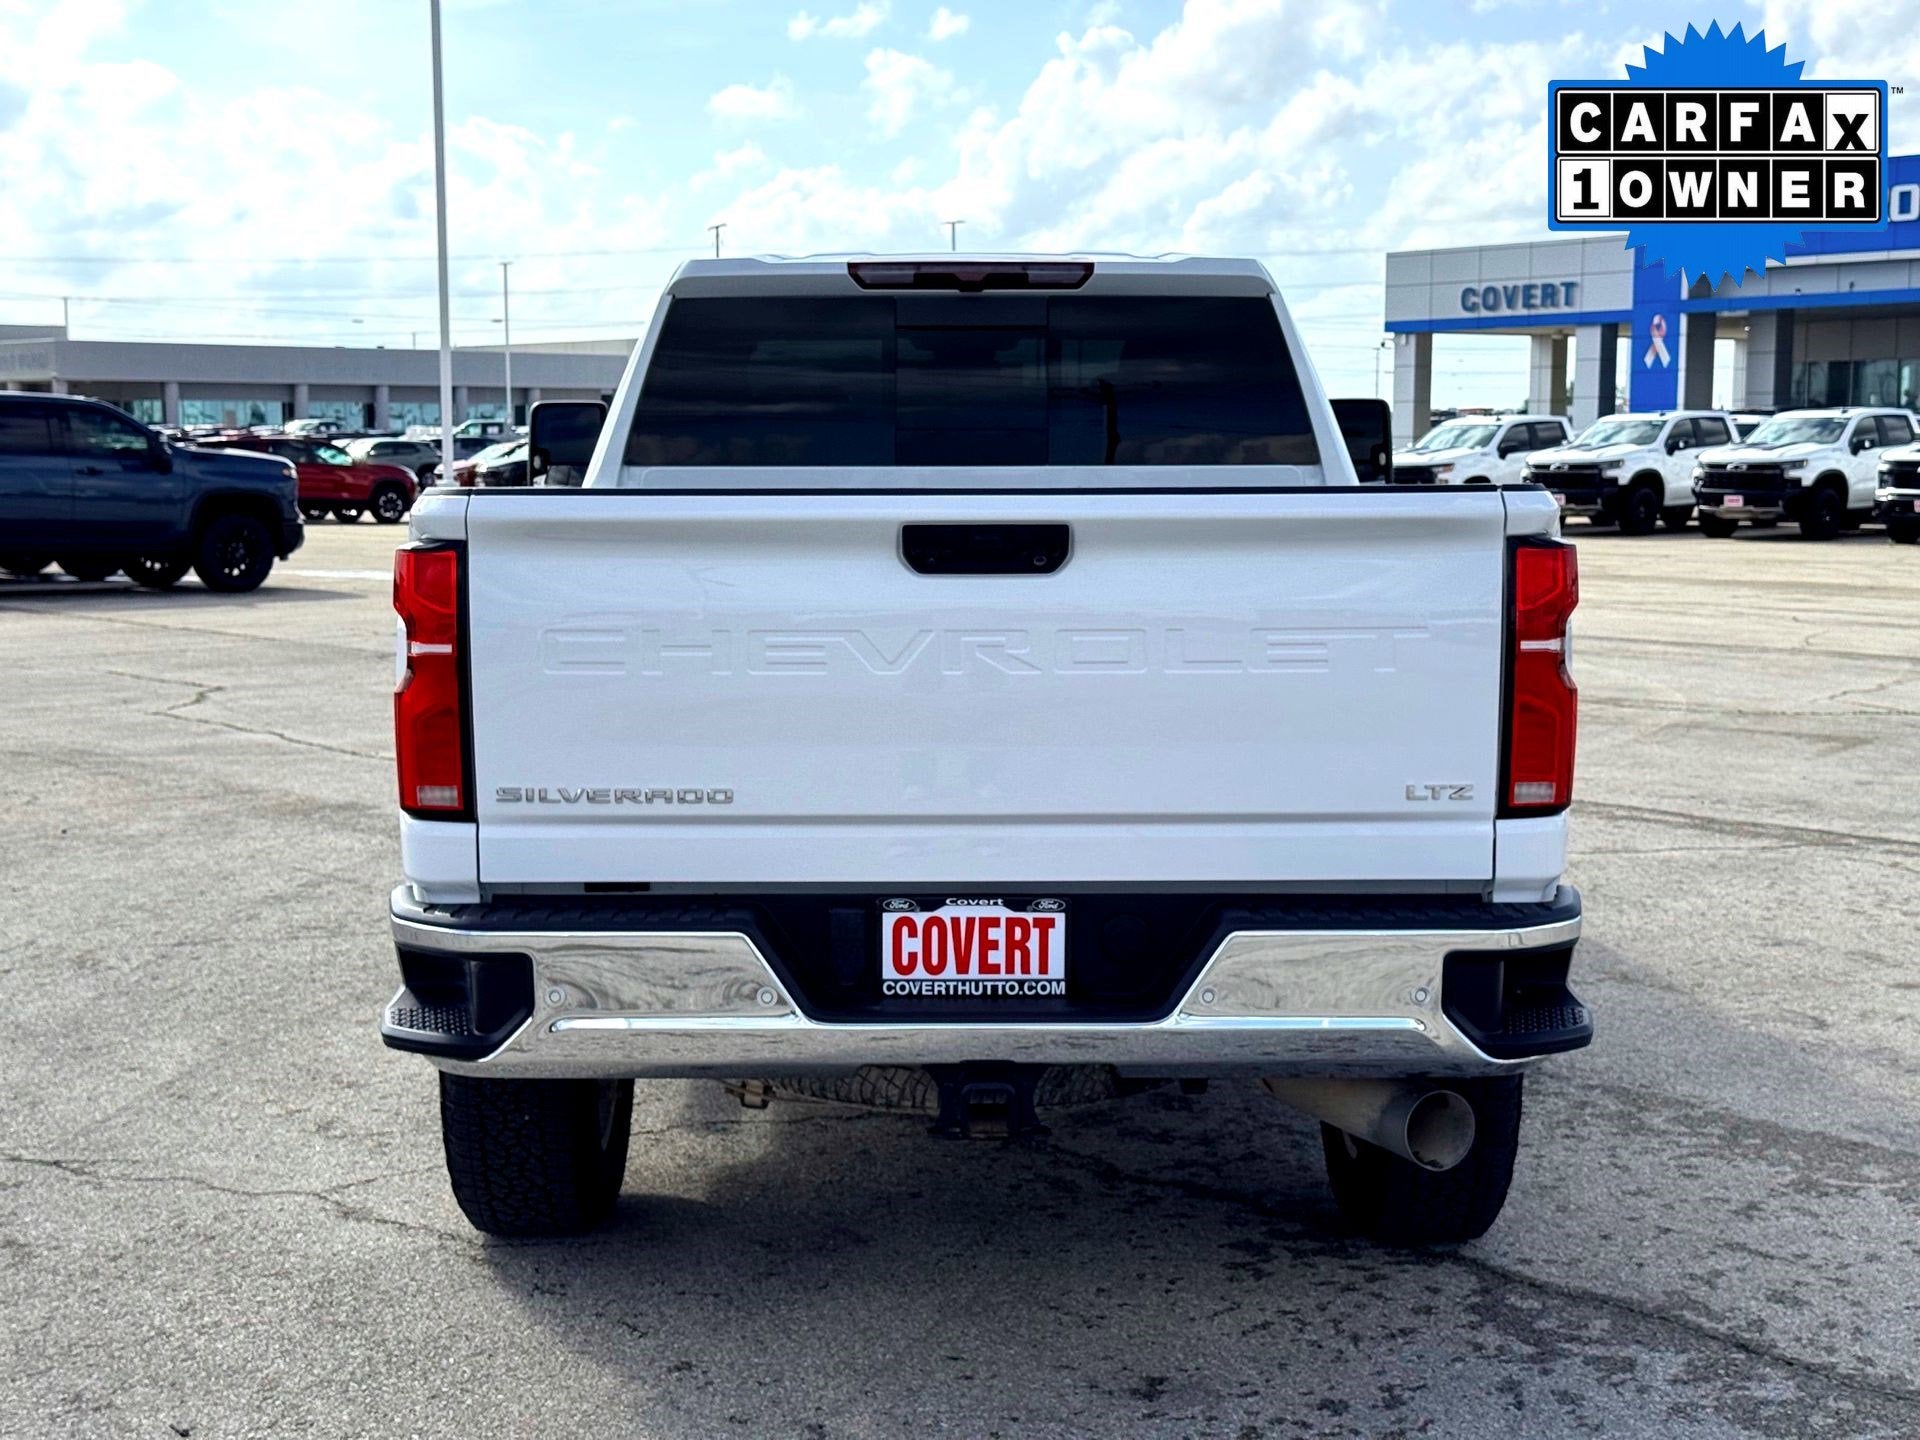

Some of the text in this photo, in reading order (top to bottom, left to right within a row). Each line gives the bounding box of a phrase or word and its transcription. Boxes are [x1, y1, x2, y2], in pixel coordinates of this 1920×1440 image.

[1460, 281, 1578, 313] COVERT
[539, 626, 1430, 676] CHEVROLET
[495, 786, 735, 805] SILVERADO
[1405, 783, 1475, 801] LTZ
[945, 897, 1004, 906] Covert
[891, 915, 1056, 976] COVERT
[882, 980, 1066, 996] COVERTHUTTO.COM
